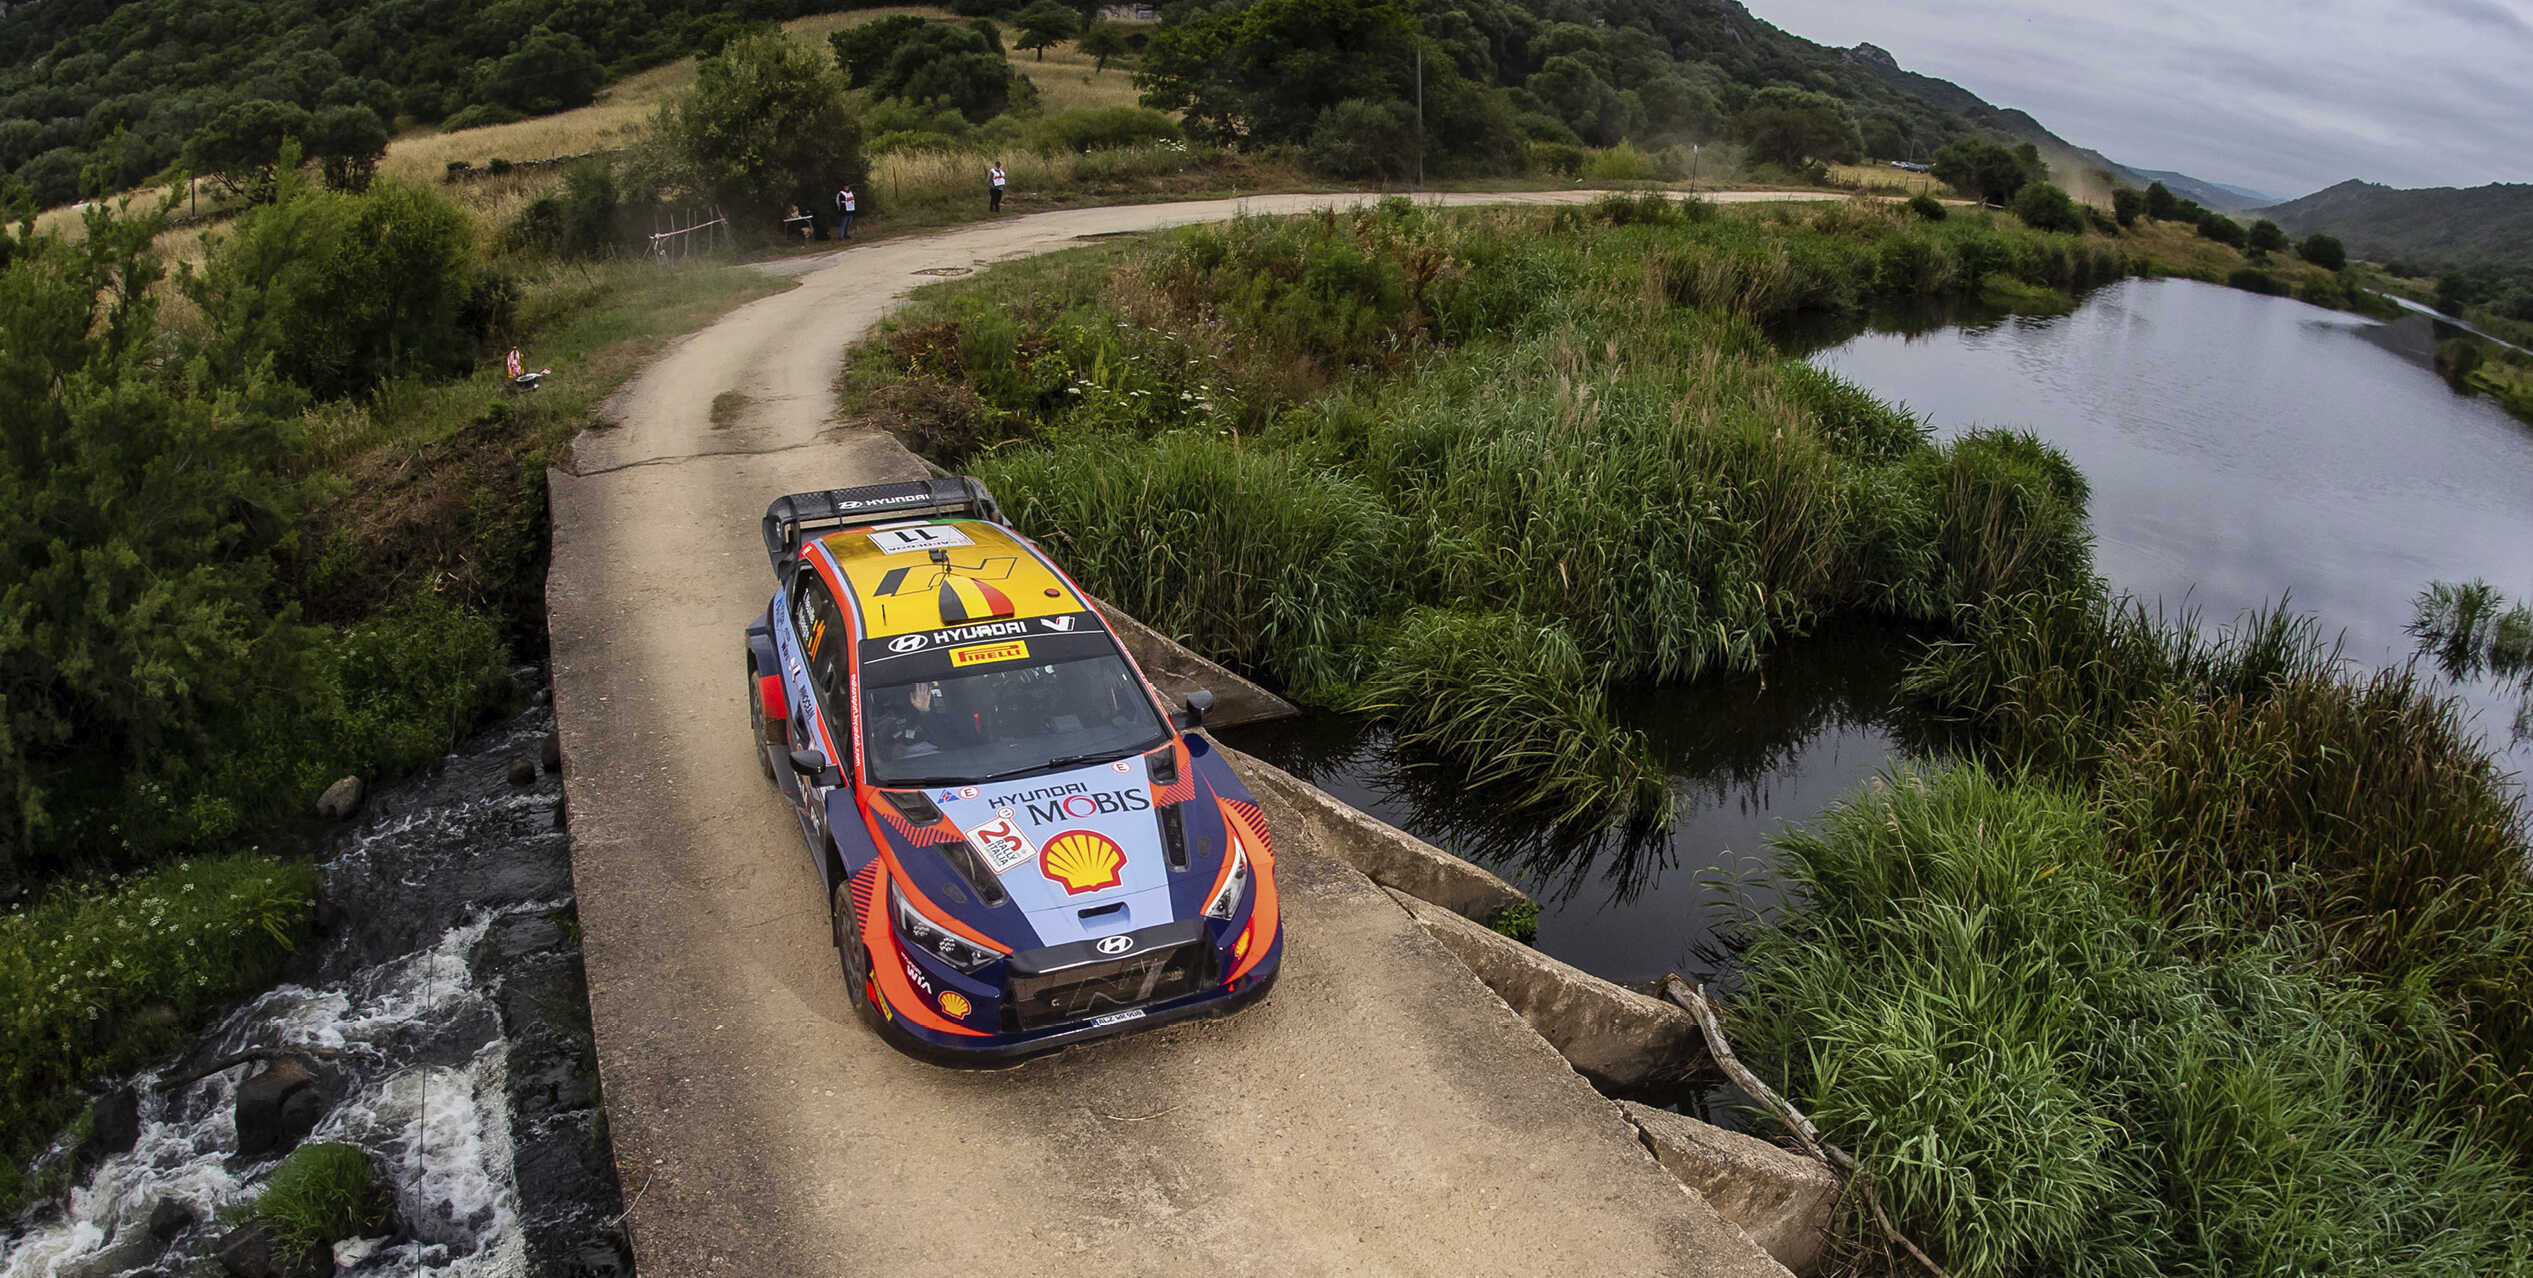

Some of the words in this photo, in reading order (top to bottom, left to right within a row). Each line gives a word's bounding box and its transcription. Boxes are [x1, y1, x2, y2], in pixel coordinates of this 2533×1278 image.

[866, 494, 929, 506] HYUNDAI
[895, 529, 938, 543] 11
[934, 621, 1027, 644] HYUNDAI
[958, 645, 1020, 663] PIRELLI
[1117, 763, 1127, 772] E
[964, 788, 975, 798] E
[989, 782, 1089, 809] HYUNDAI
[1027, 788, 1150, 825] MOBIS
[988, 842, 1009, 865] ITALIA
[996, 839, 1017, 860] RALLY
